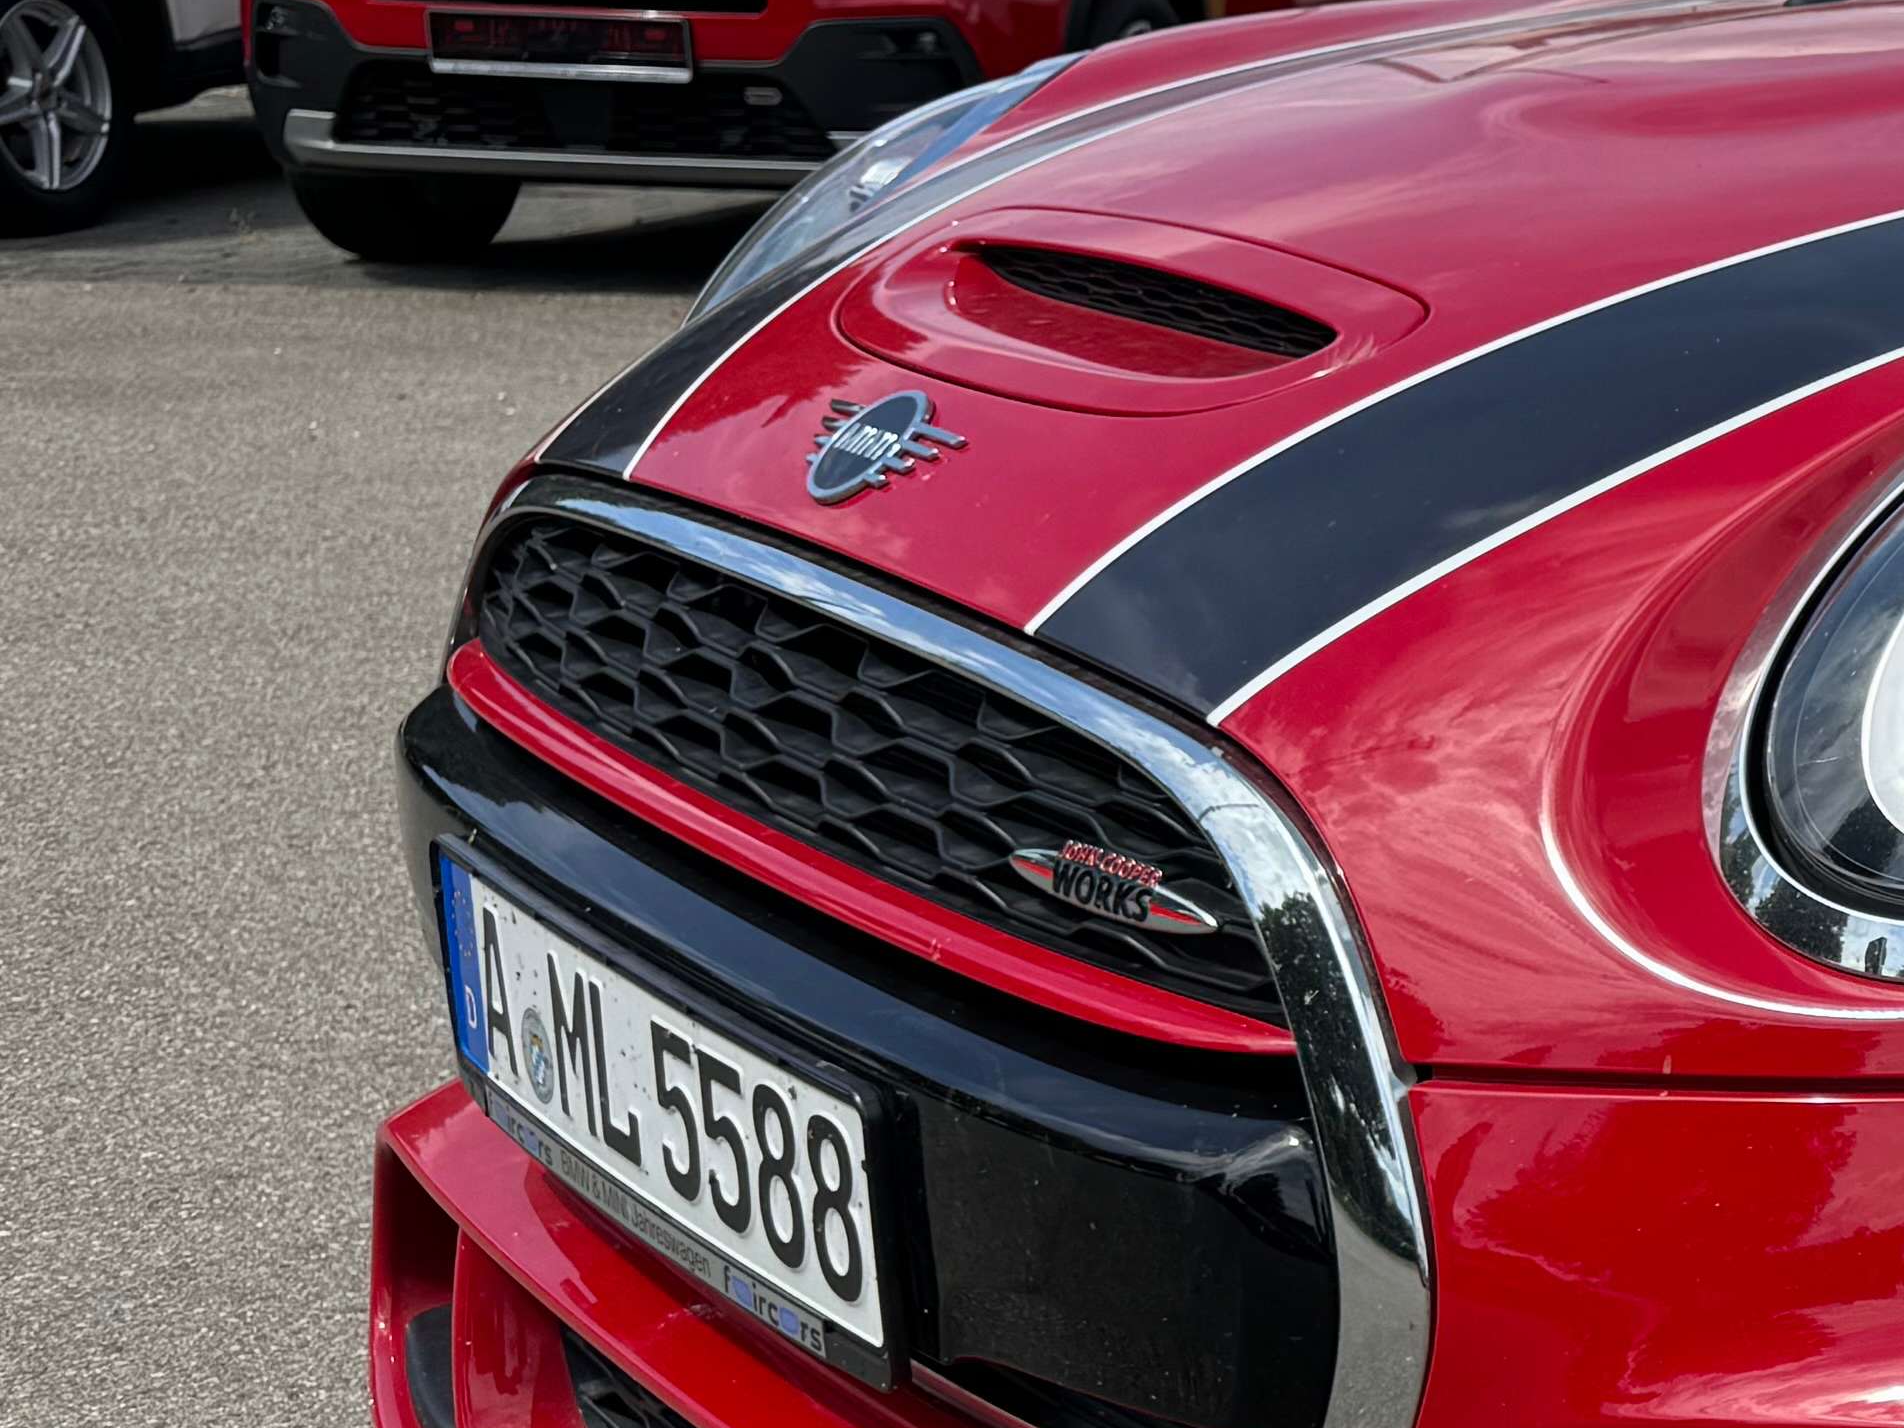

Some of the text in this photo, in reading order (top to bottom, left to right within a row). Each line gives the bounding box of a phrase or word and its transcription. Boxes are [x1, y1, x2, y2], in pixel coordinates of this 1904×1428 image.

[1053, 859, 1152, 922] WORKS
[1059, 839, 1163, 888] JOHN COOPER
[465, 985, 478, 1029] D
[483, 907, 862, 1302] A ML 5588
